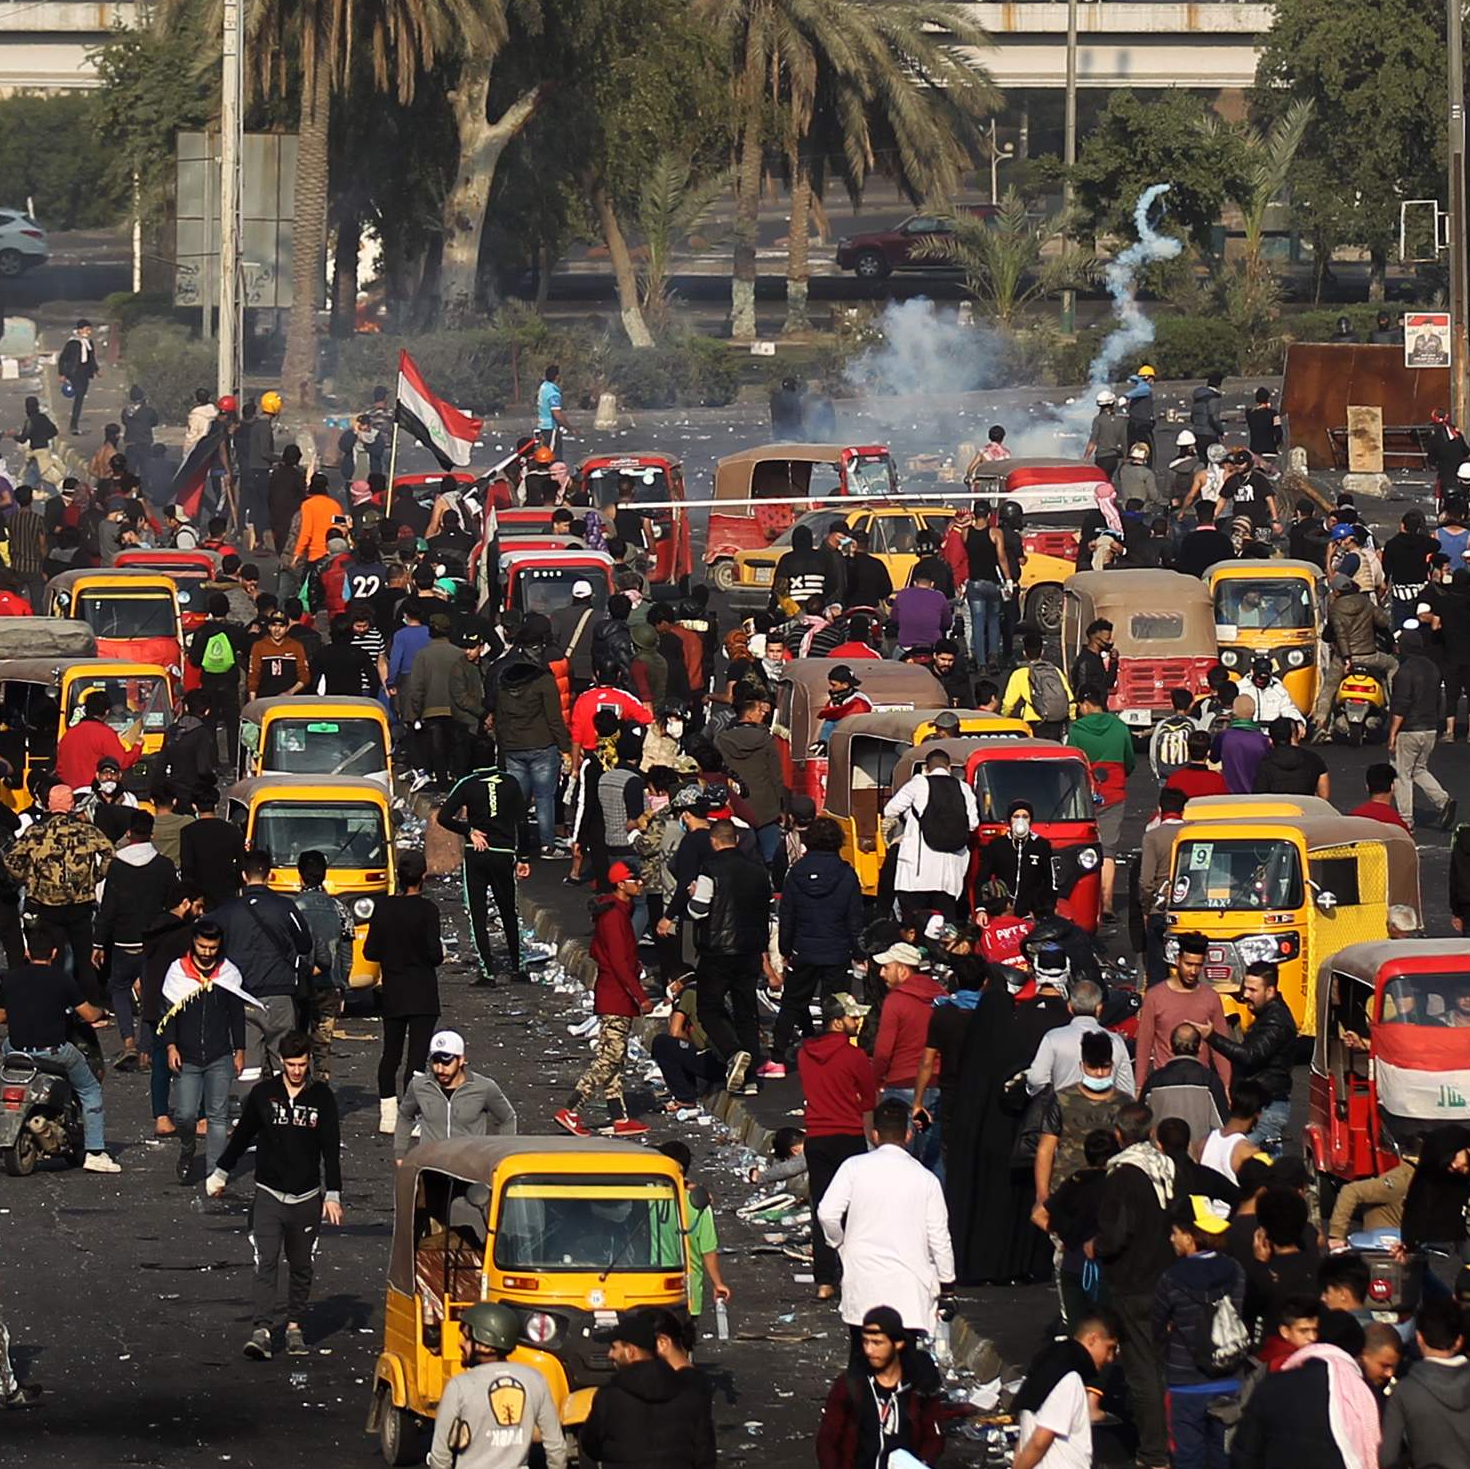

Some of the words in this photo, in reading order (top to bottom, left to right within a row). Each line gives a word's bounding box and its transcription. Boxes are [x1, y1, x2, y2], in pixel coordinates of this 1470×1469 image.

[353, 575, 380, 598] 22
[487, 782, 498, 818] DIADORA
[1196, 849, 1208, 865] 9
